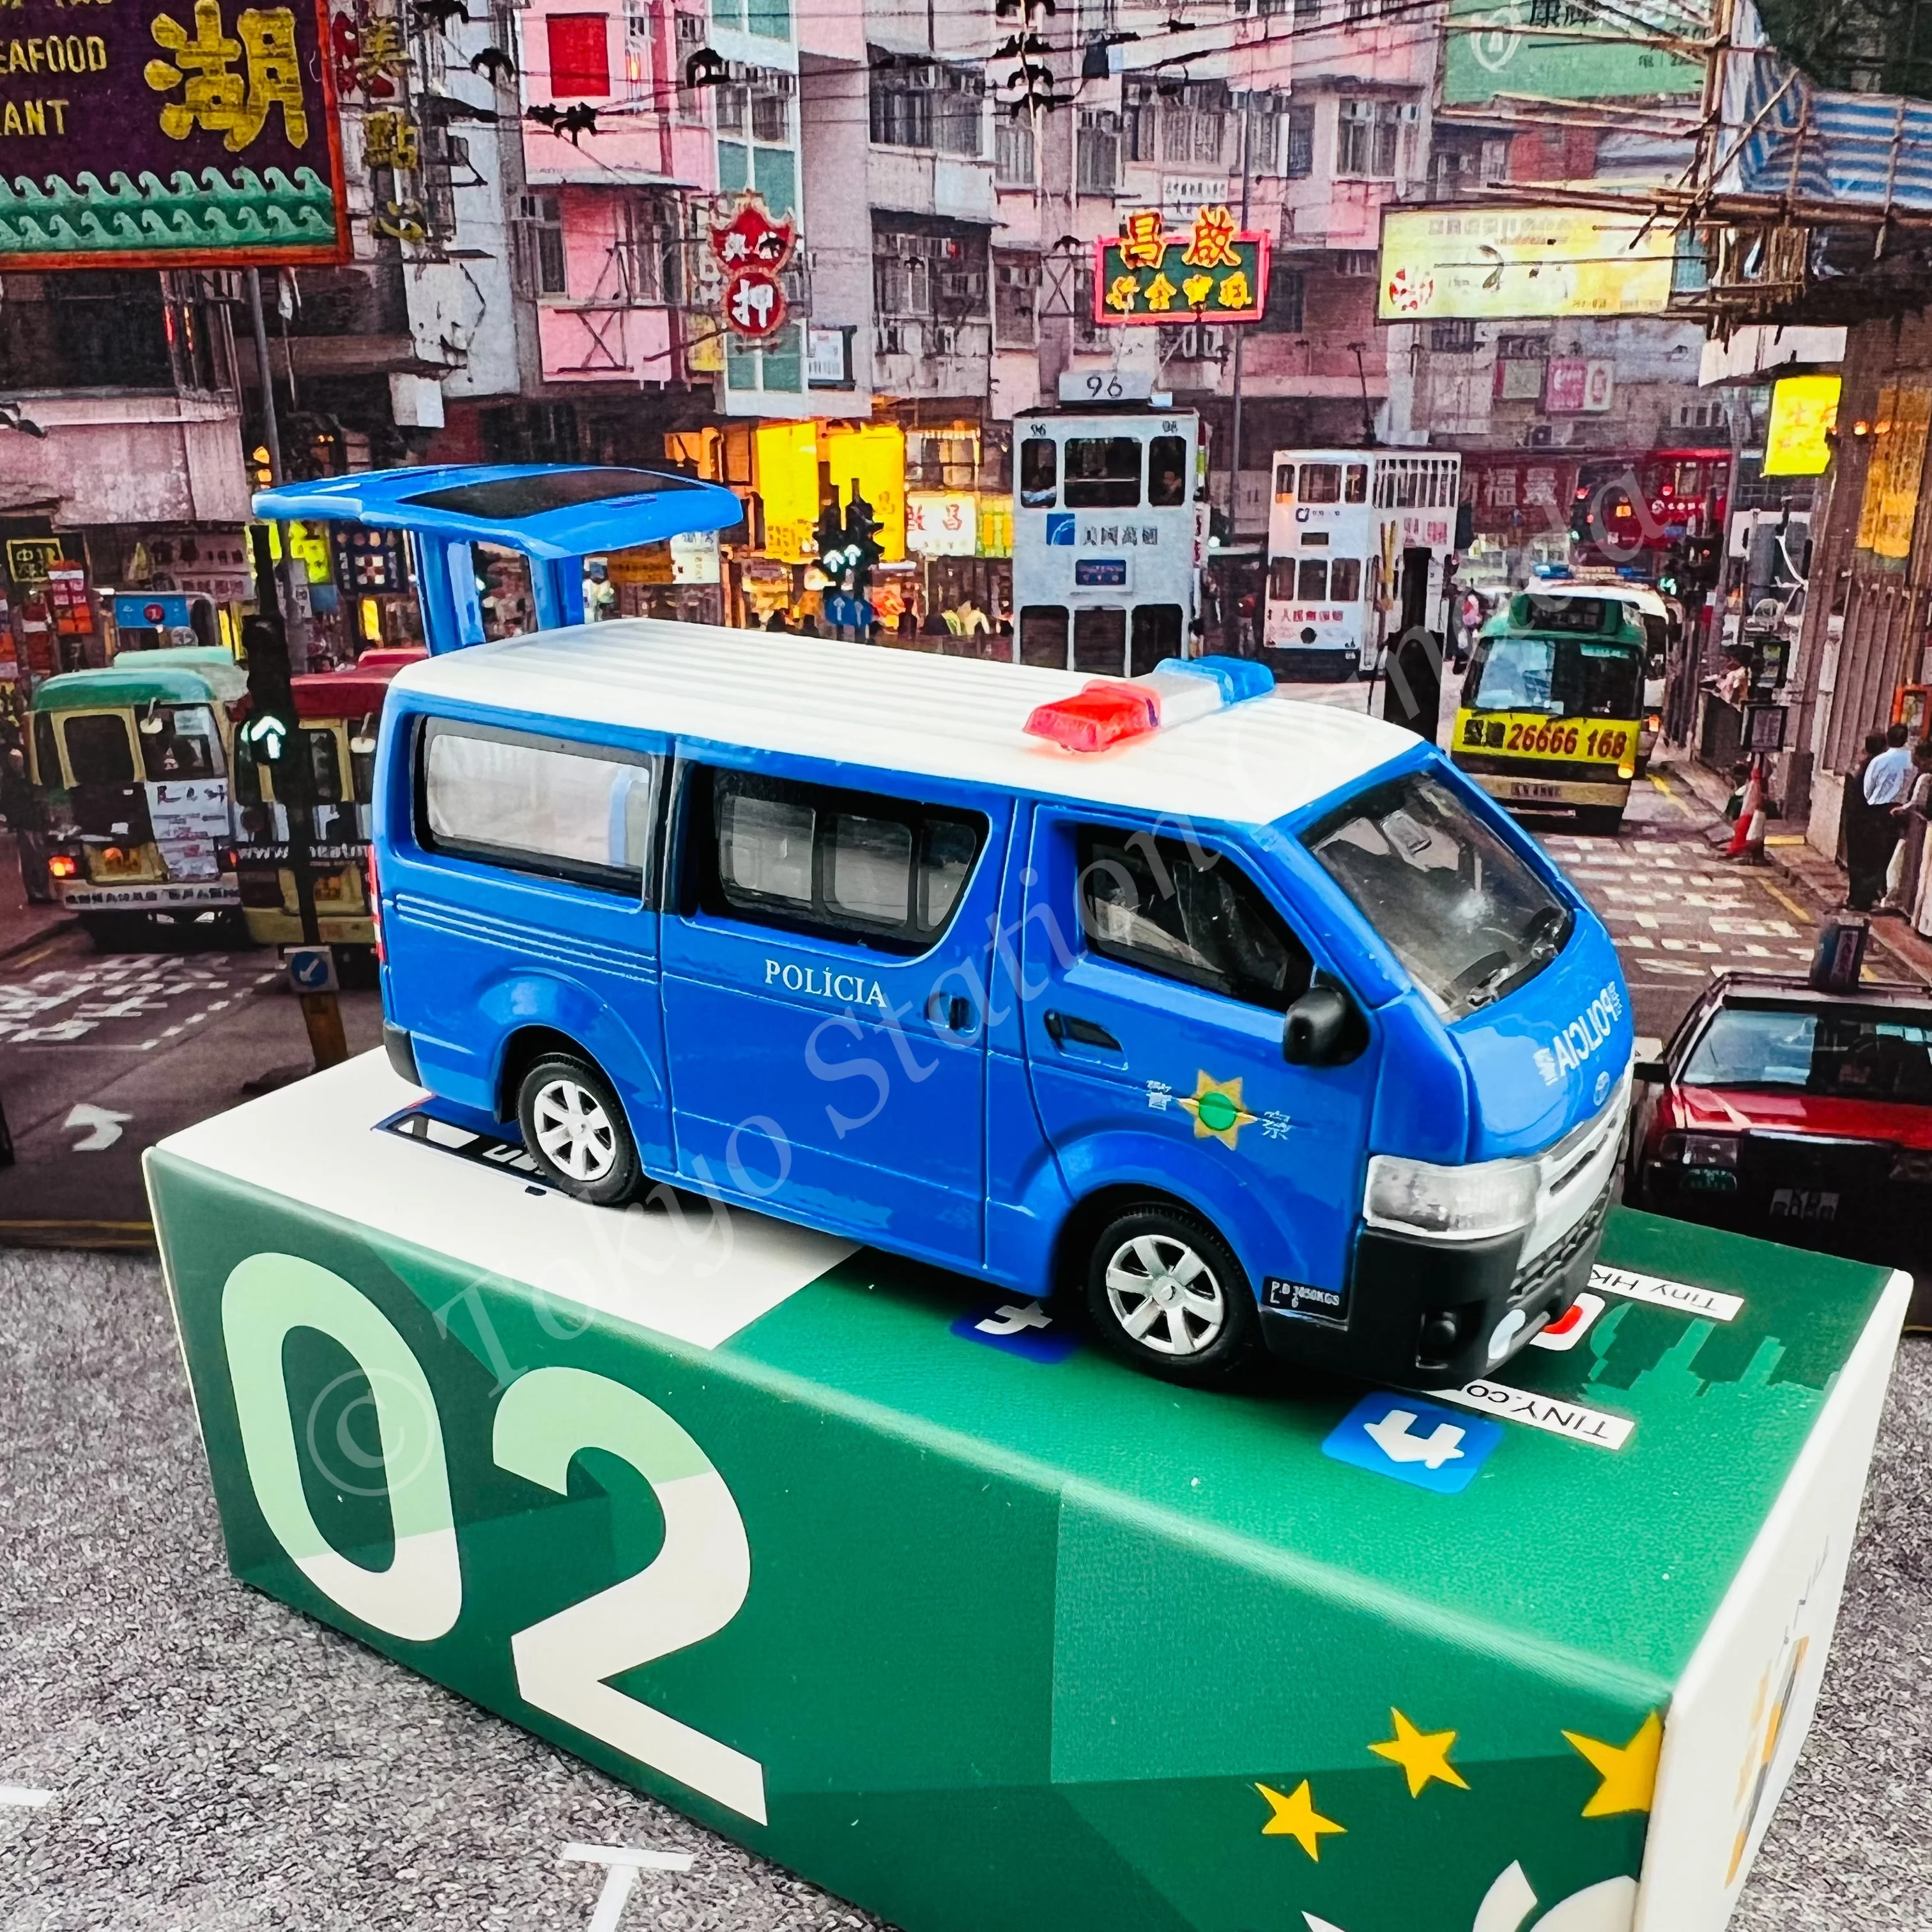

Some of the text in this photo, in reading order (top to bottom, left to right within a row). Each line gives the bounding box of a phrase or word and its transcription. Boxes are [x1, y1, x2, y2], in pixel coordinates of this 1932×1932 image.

[1087, 376, 1123, 398] 96
[1506, 723, 1579, 755] 26666
[1587, 728, 1627, 759] 168
[765, 959, 887, 1008] POLÍCIA
[221, 1252, 768, 1827] 02
